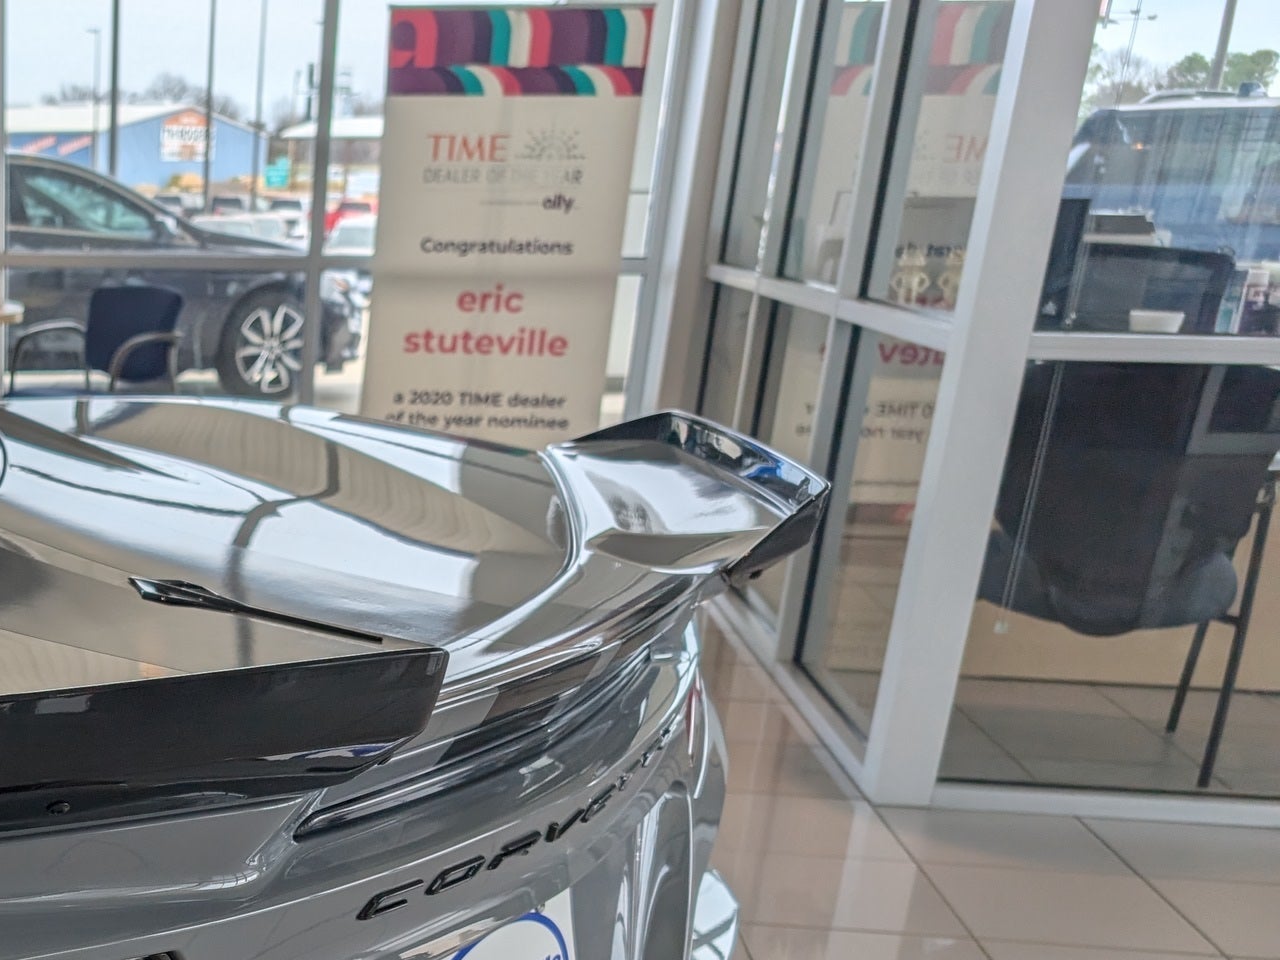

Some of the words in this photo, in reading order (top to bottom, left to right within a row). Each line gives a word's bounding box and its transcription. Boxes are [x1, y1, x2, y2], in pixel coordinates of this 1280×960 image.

[426, 134, 510, 162] TIME
[422, 167, 480, 184] DEALER
[542, 193, 575, 215] ally
[420, 237, 574, 257] Congratulations
[456, 283, 524, 314] eric
[403, 328, 569, 357] stuteville
[393, 392, 405, 404] a
[409, 390, 453, 406] 2020
[459, 391, 502, 407] TIME
[507, 393, 567, 409] dealer
[385, 411, 405, 422] of
[408, 411, 439, 426] the
[443, 415, 484, 430] year
[487, 414, 569, 430] nominee
